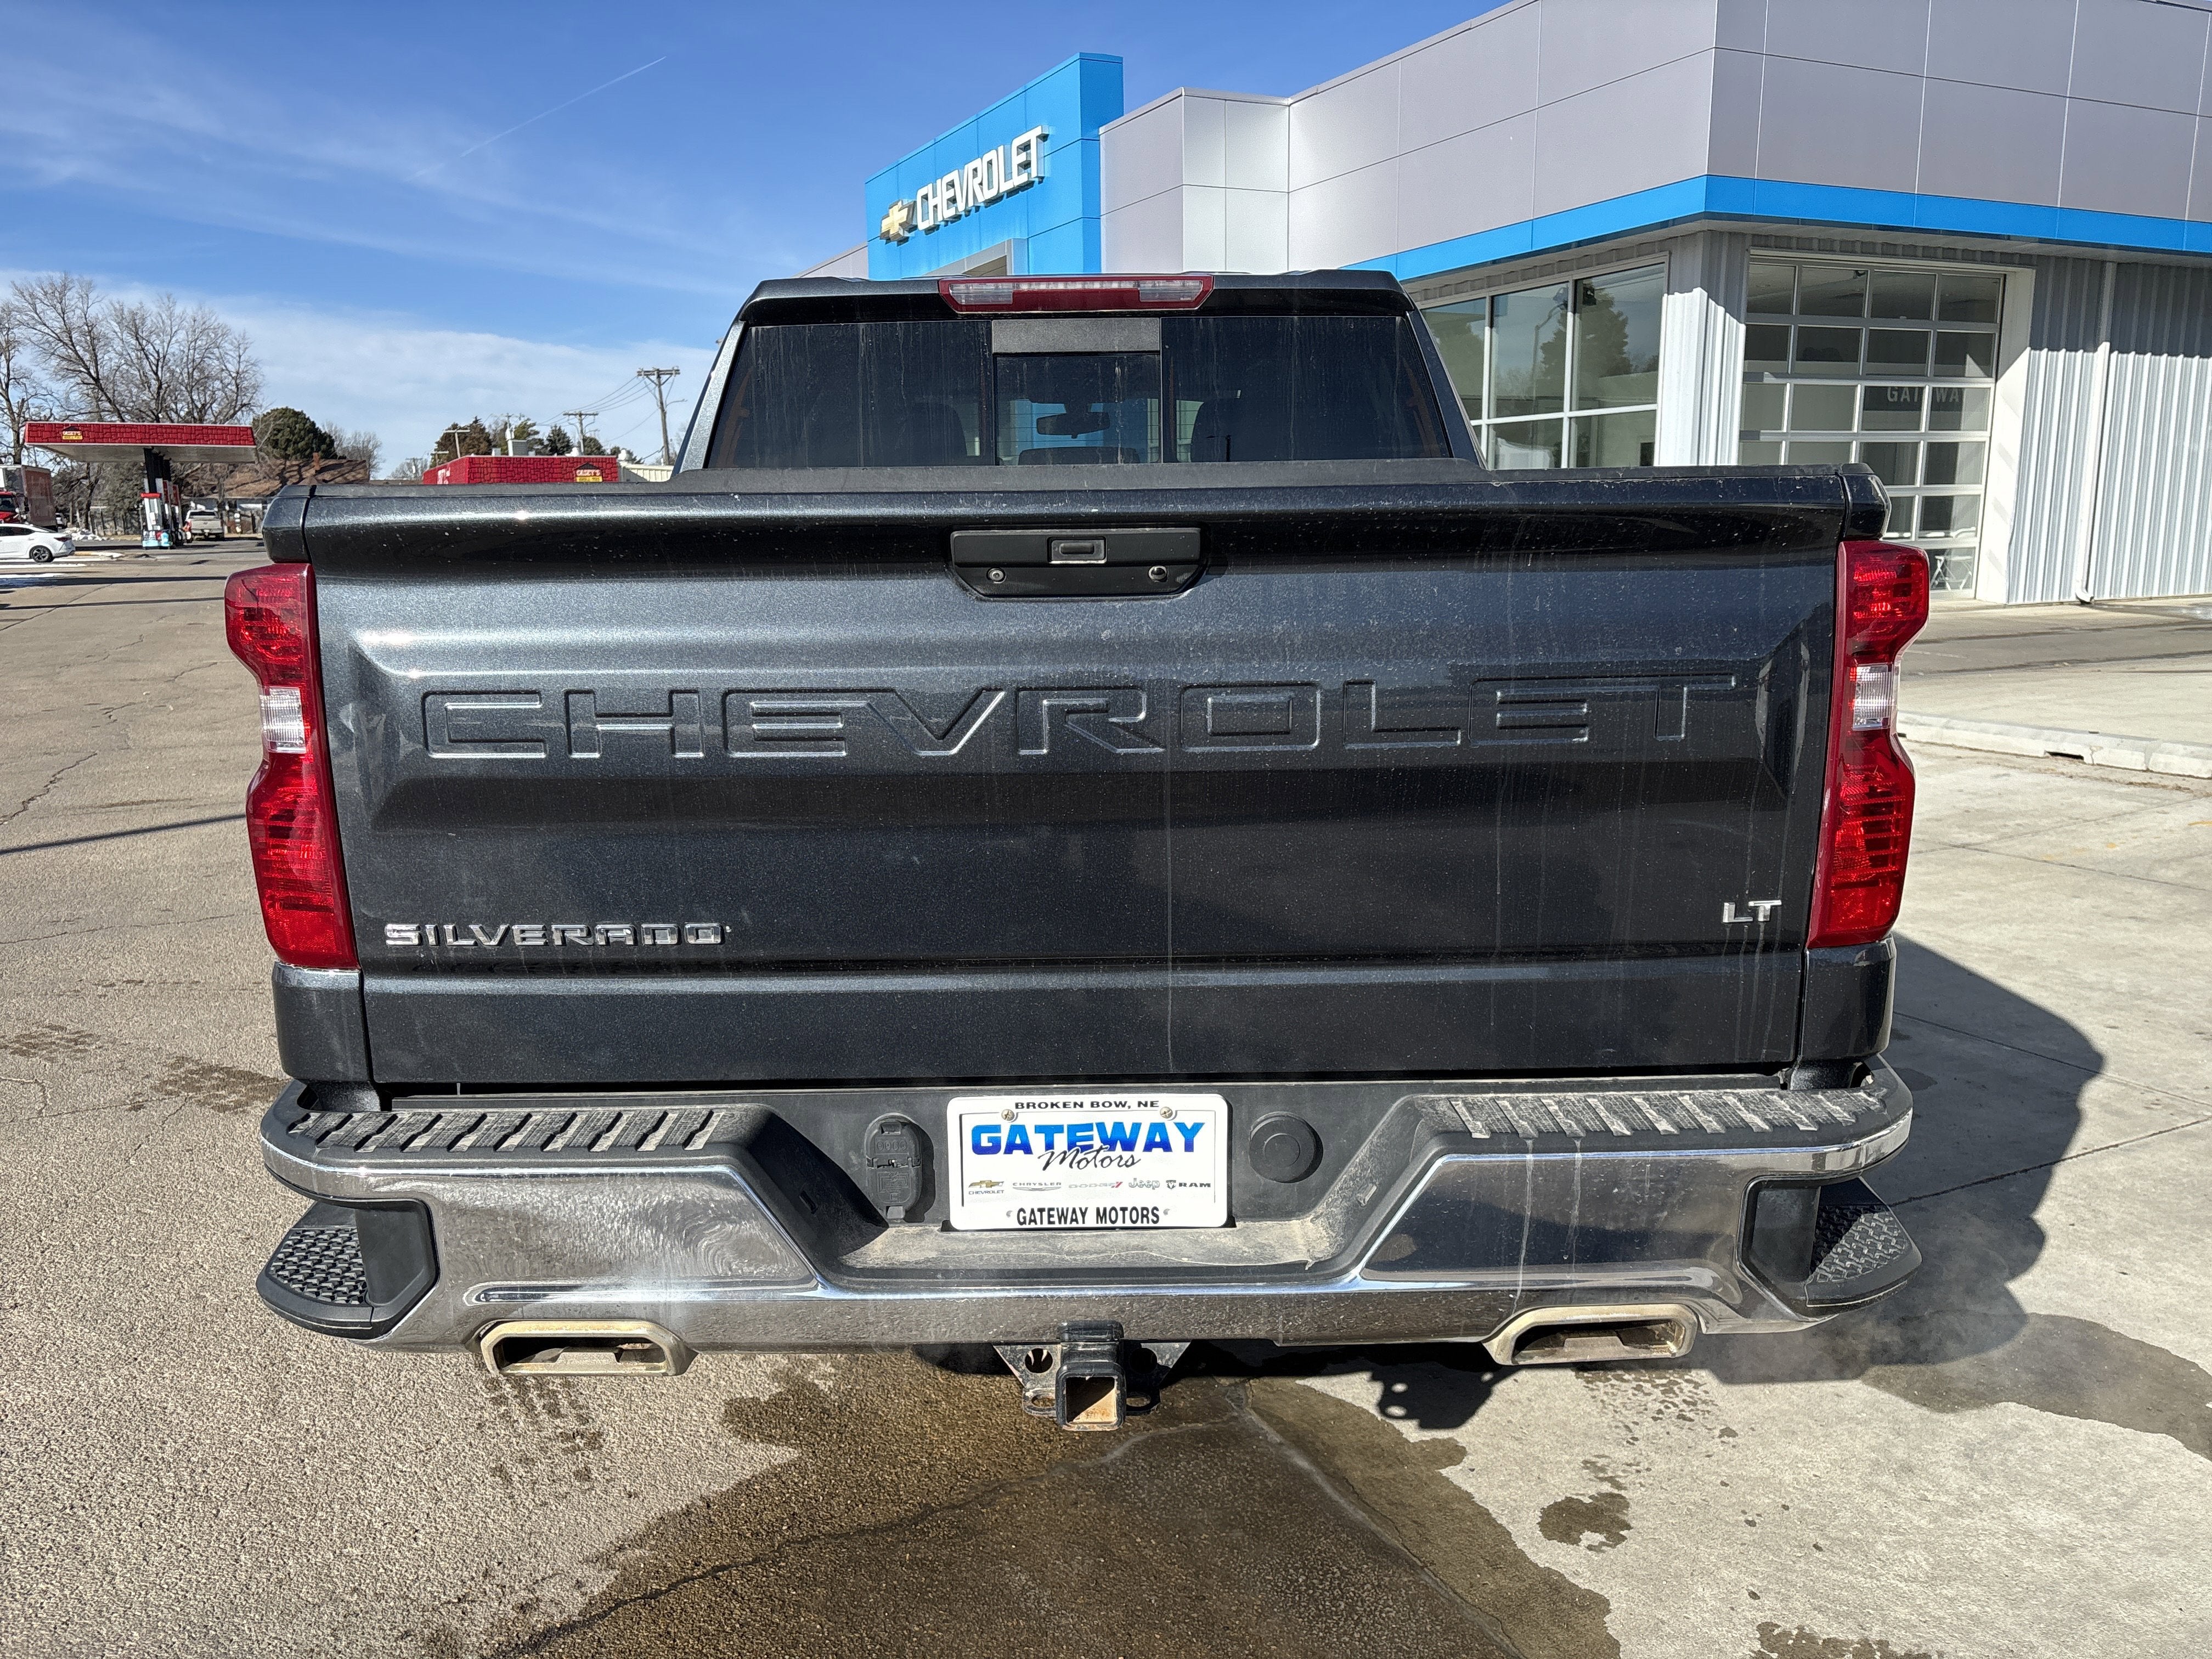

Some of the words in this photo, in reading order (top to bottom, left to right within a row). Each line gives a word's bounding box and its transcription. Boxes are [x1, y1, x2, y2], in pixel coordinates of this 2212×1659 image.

[917, 125, 1047, 231] CHEVROLET
[422, 673, 1736, 759] CHEVROLET
[1722, 899, 1782, 923] LT
[385, 923, 726, 947] SILVERADO
[1090, 1101, 1132, 1109] BOW,
[971, 1121, 1205, 1155] GATEWAY
[1037, 1145, 1141, 1171] Motors
[1128, 1178, 1160, 1190] Jeep
[1017, 1207, 1088, 1226] GATEWAY
[1096, 1206, 1160, 1225] MOTORS
